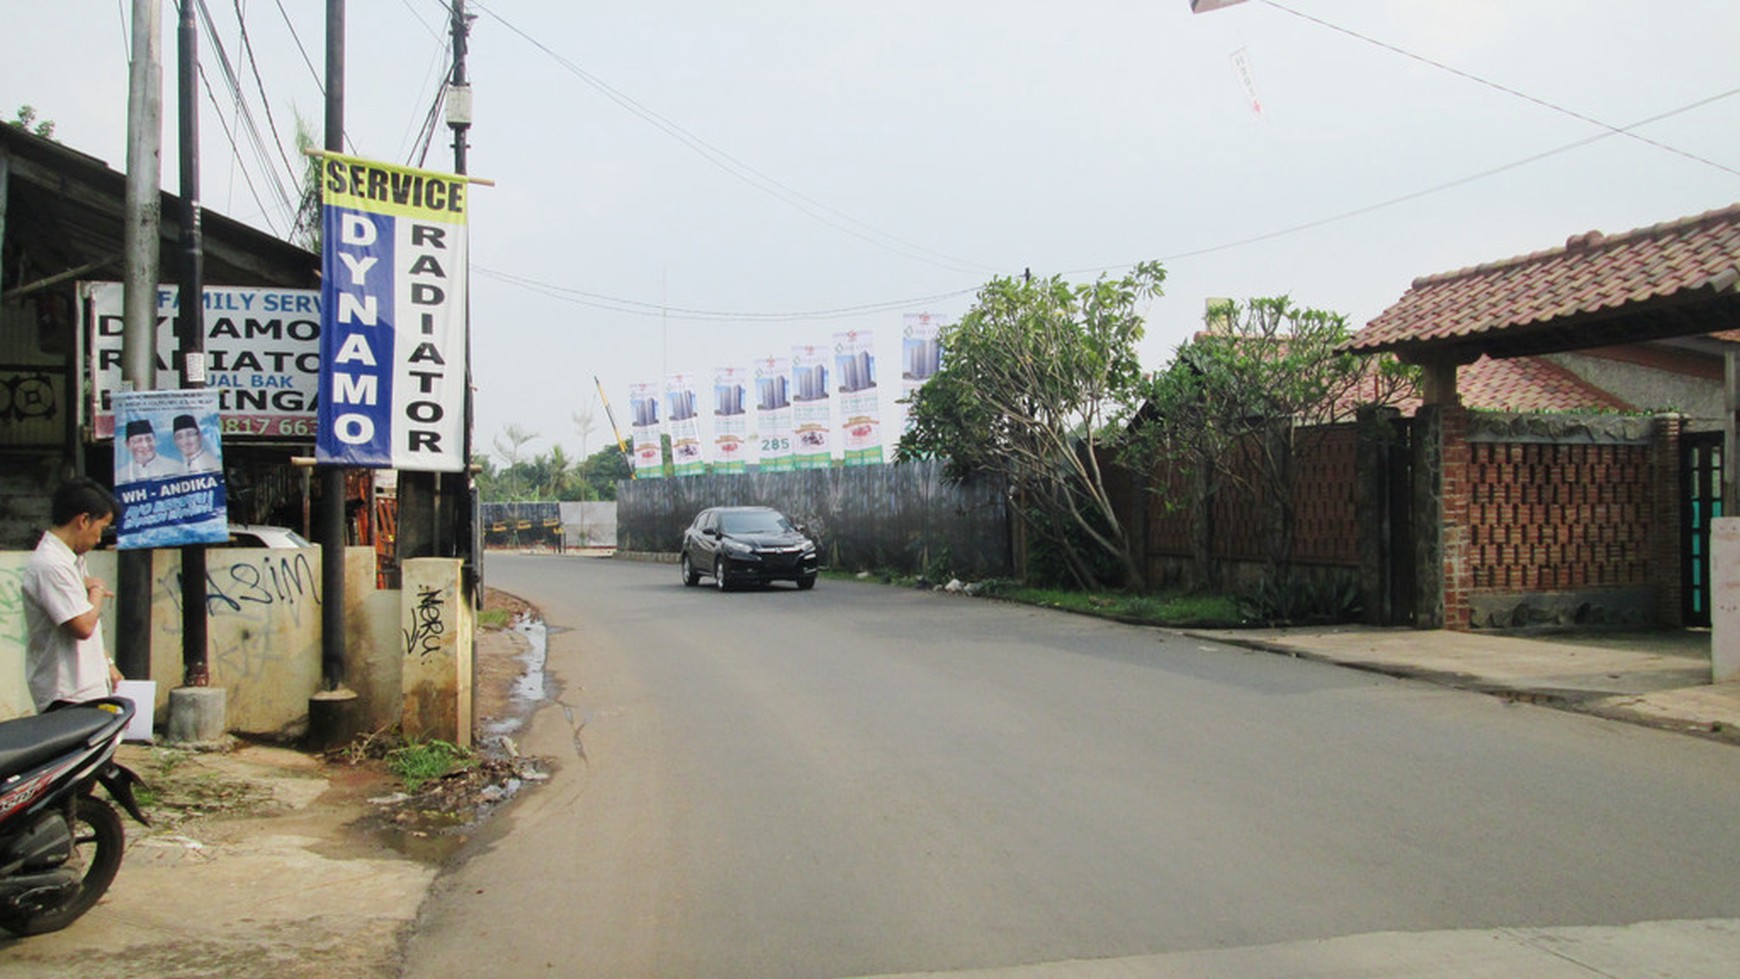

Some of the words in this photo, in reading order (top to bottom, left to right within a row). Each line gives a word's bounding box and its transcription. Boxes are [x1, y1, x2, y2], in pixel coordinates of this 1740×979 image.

[327, 159, 463, 213] SERVICE
[333, 213, 378, 445] DYNAMO
[406, 223, 447, 453] RADIATOR
[251, 375, 293, 388] BAK
[762, 439, 789, 451] 285
[122, 489, 147, 504] WH
[161, 477, 218, 497] ANDIKA
